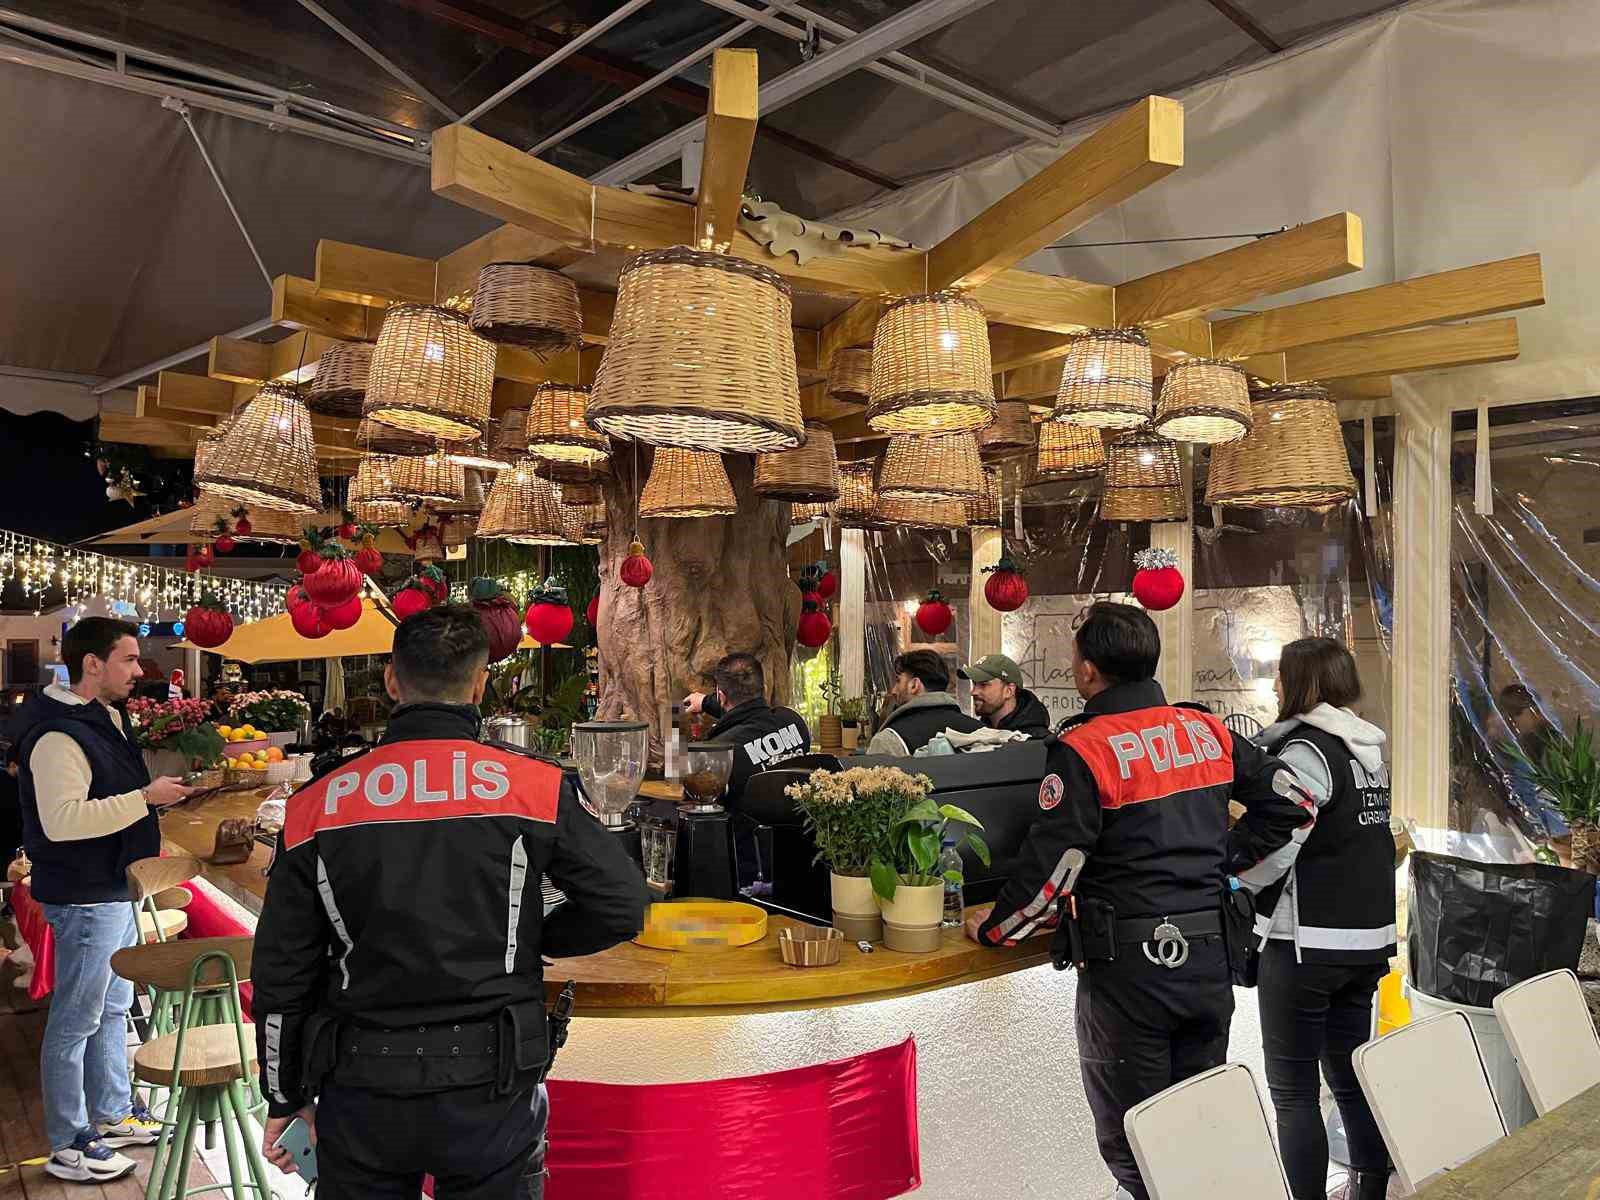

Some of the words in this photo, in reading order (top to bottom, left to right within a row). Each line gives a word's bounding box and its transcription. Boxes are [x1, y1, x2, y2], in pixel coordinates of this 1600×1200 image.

[743, 723, 803, 765] KOM
[1107, 714, 1222, 780] POLİS
[324, 751, 510, 815] POLİS
